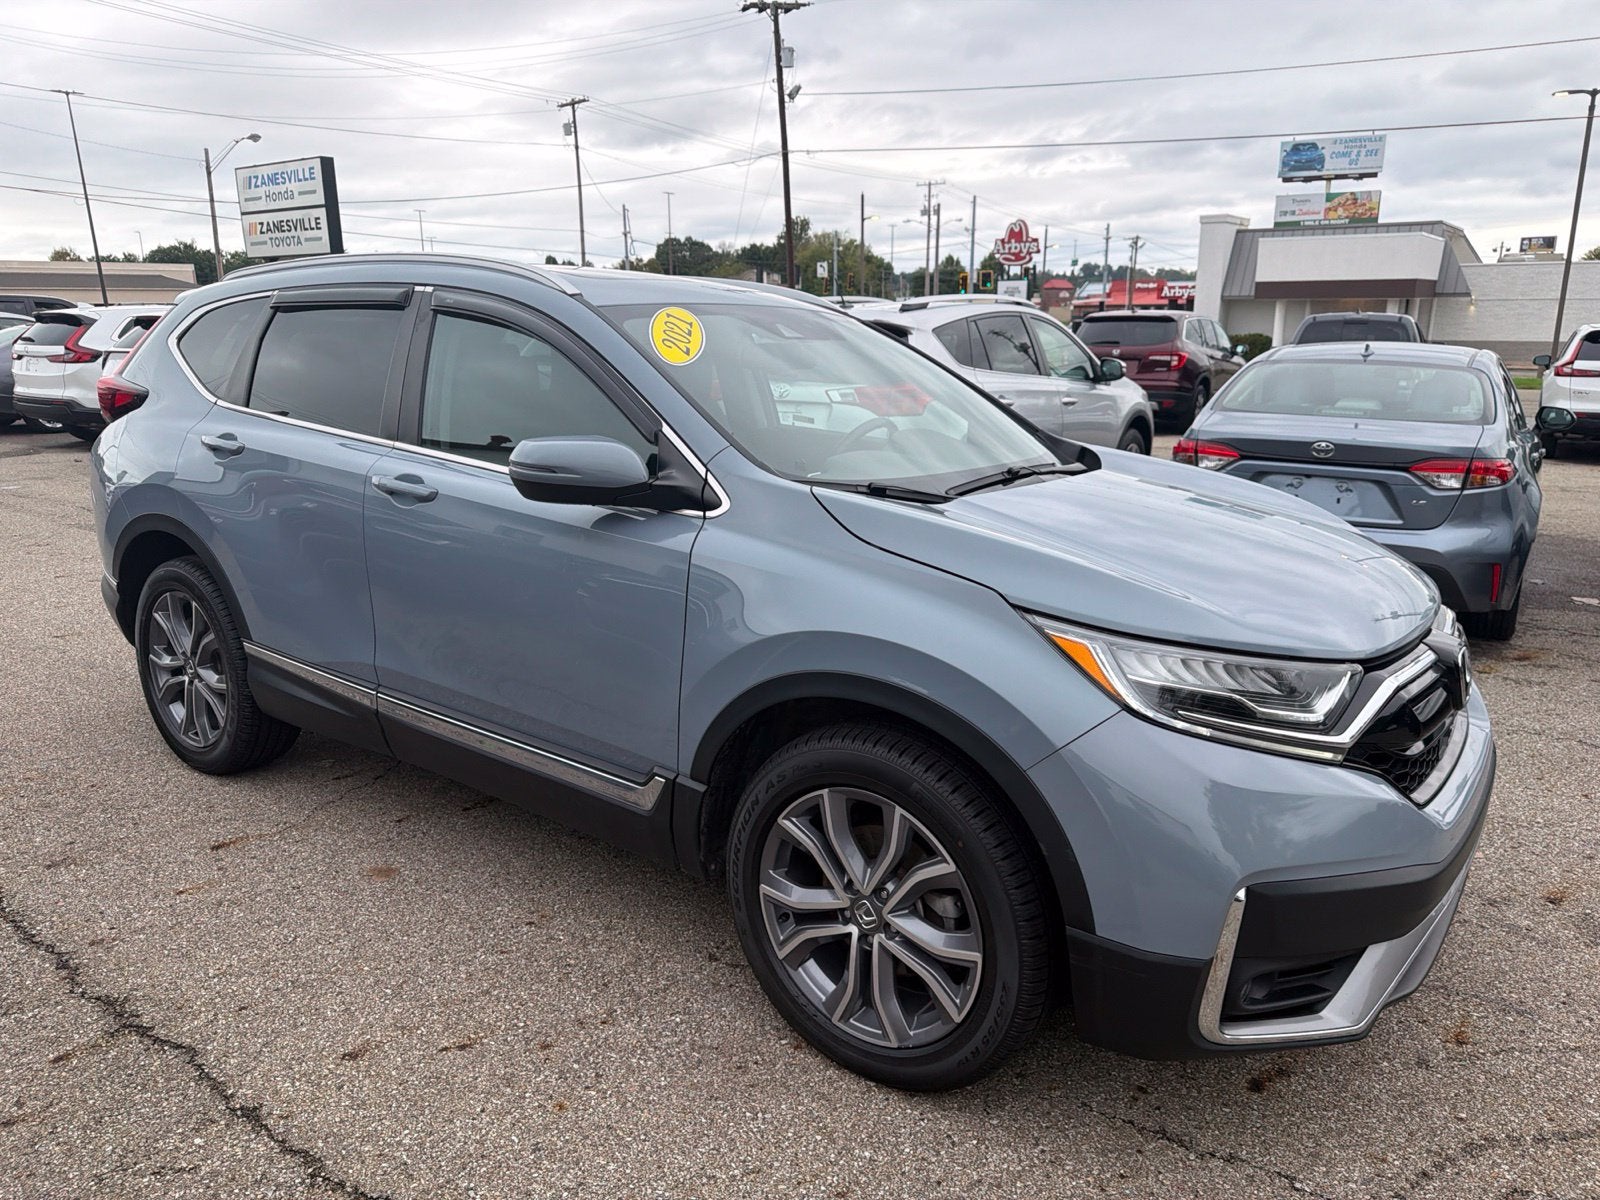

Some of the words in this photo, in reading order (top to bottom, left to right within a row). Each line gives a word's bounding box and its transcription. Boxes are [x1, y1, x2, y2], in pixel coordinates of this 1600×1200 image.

[1339, 137, 1383, 145] ZANESVILLE
[1330, 150, 1353, 159] COME
[1355, 150, 1361, 158] &
[1364, 148, 1379, 157] SEE
[1348, 158, 1360, 166] US
[253, 166, 316, 189] ZANESVILLE
[264, 187, 295, 203] Honda
[258, 216, 322, 235] ZANESVILLE
[269, 235, 303, 248] TOYOTA
[994, 237, 1037, 256] Arby's
[662, 312, 693, 356] 2021
[765, 774, 787, 794] AS
